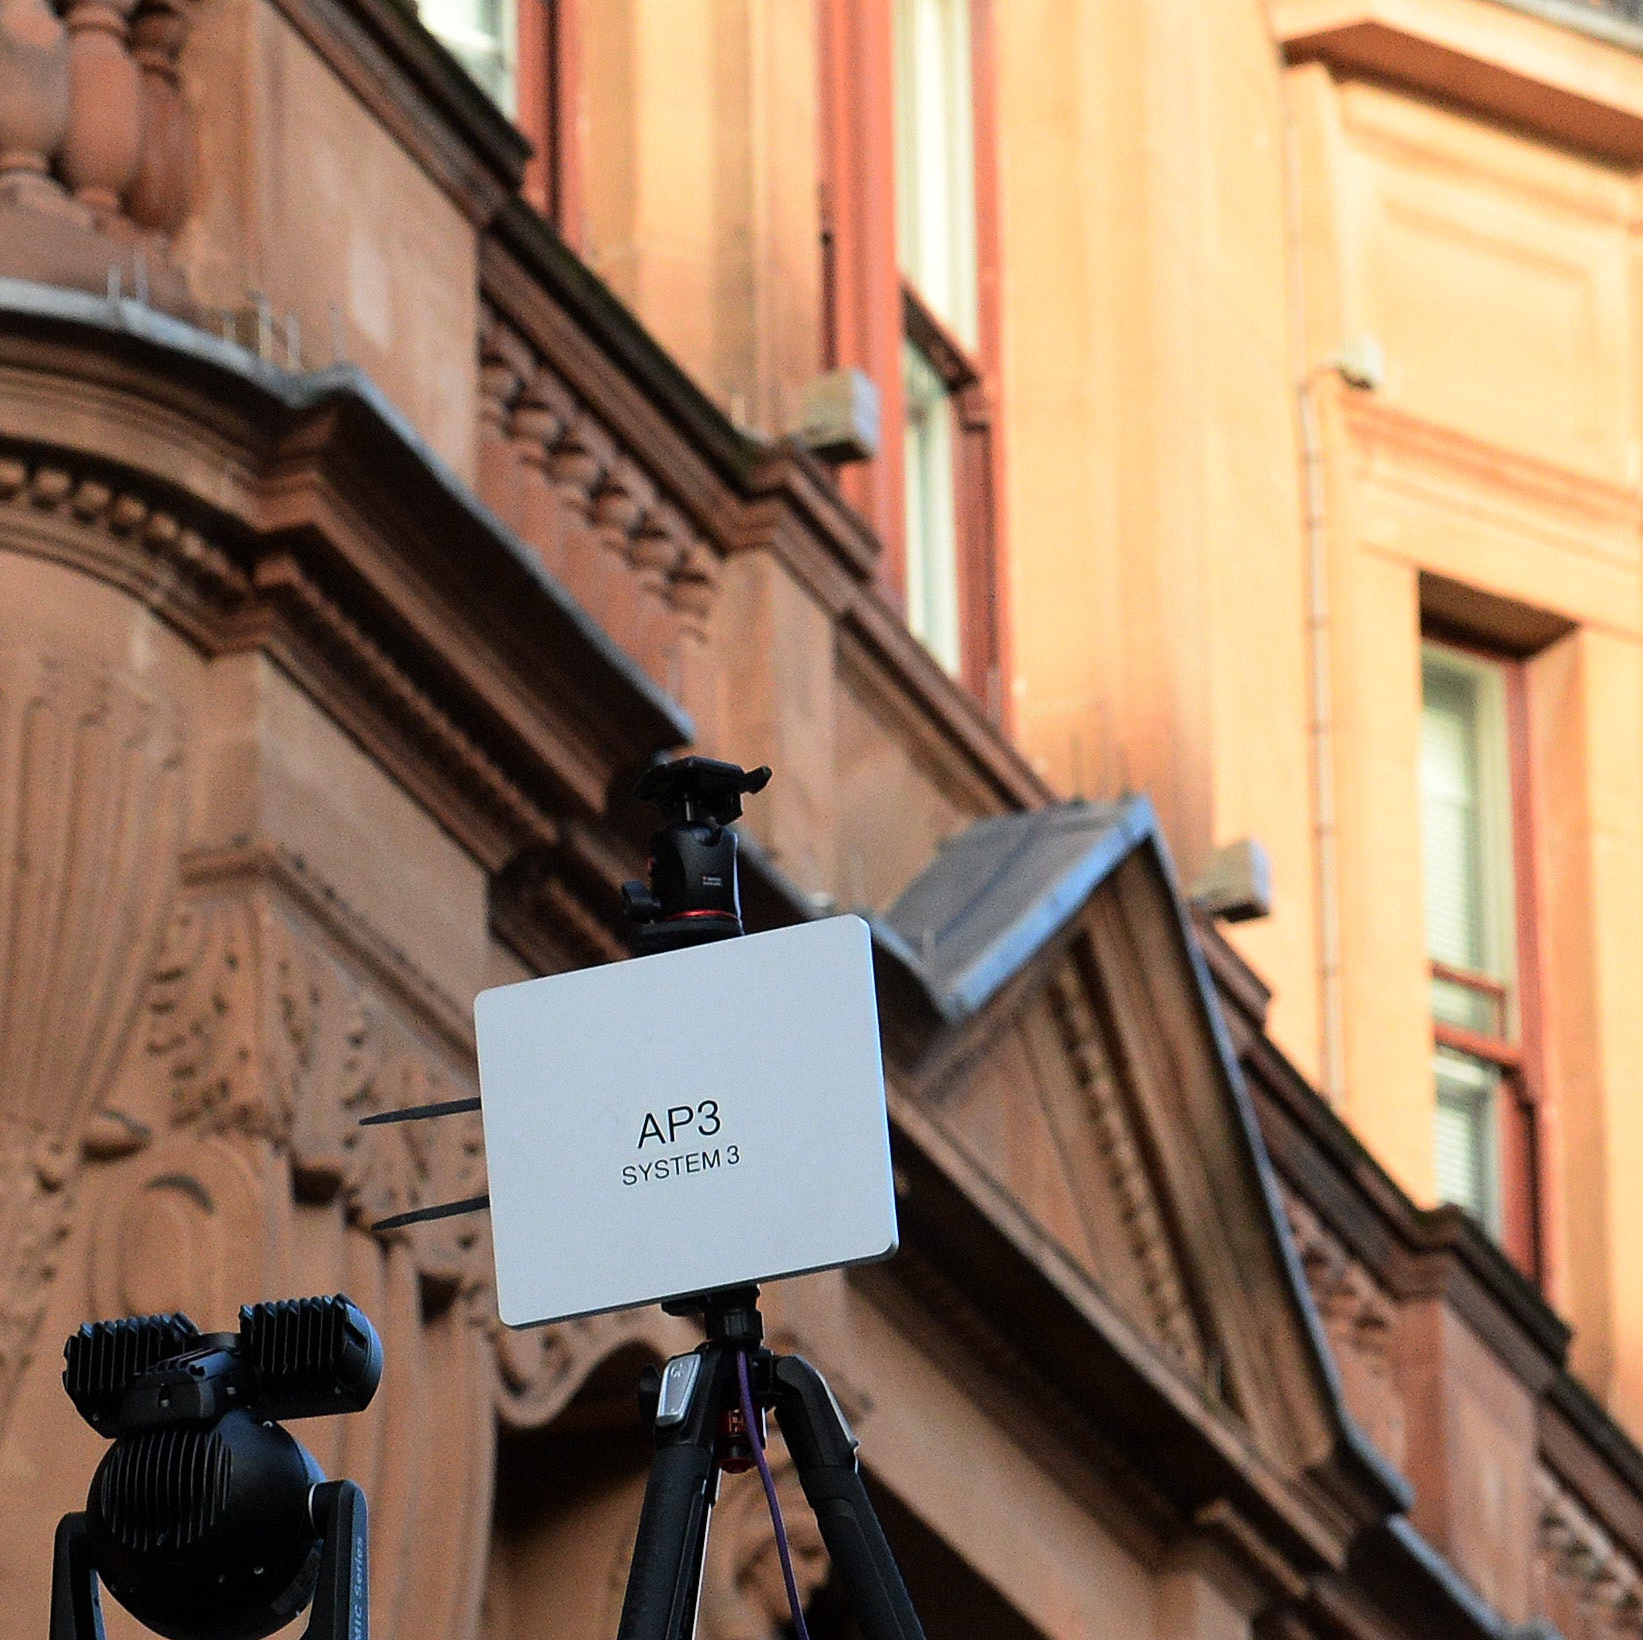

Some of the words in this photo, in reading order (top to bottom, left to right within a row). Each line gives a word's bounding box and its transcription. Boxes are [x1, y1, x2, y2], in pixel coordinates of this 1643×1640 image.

[637, 1099, 721, 1149] AP3
[622, 1149, 721, 1186] SYSTEM
[726, 1145, 740, 1165] 3
